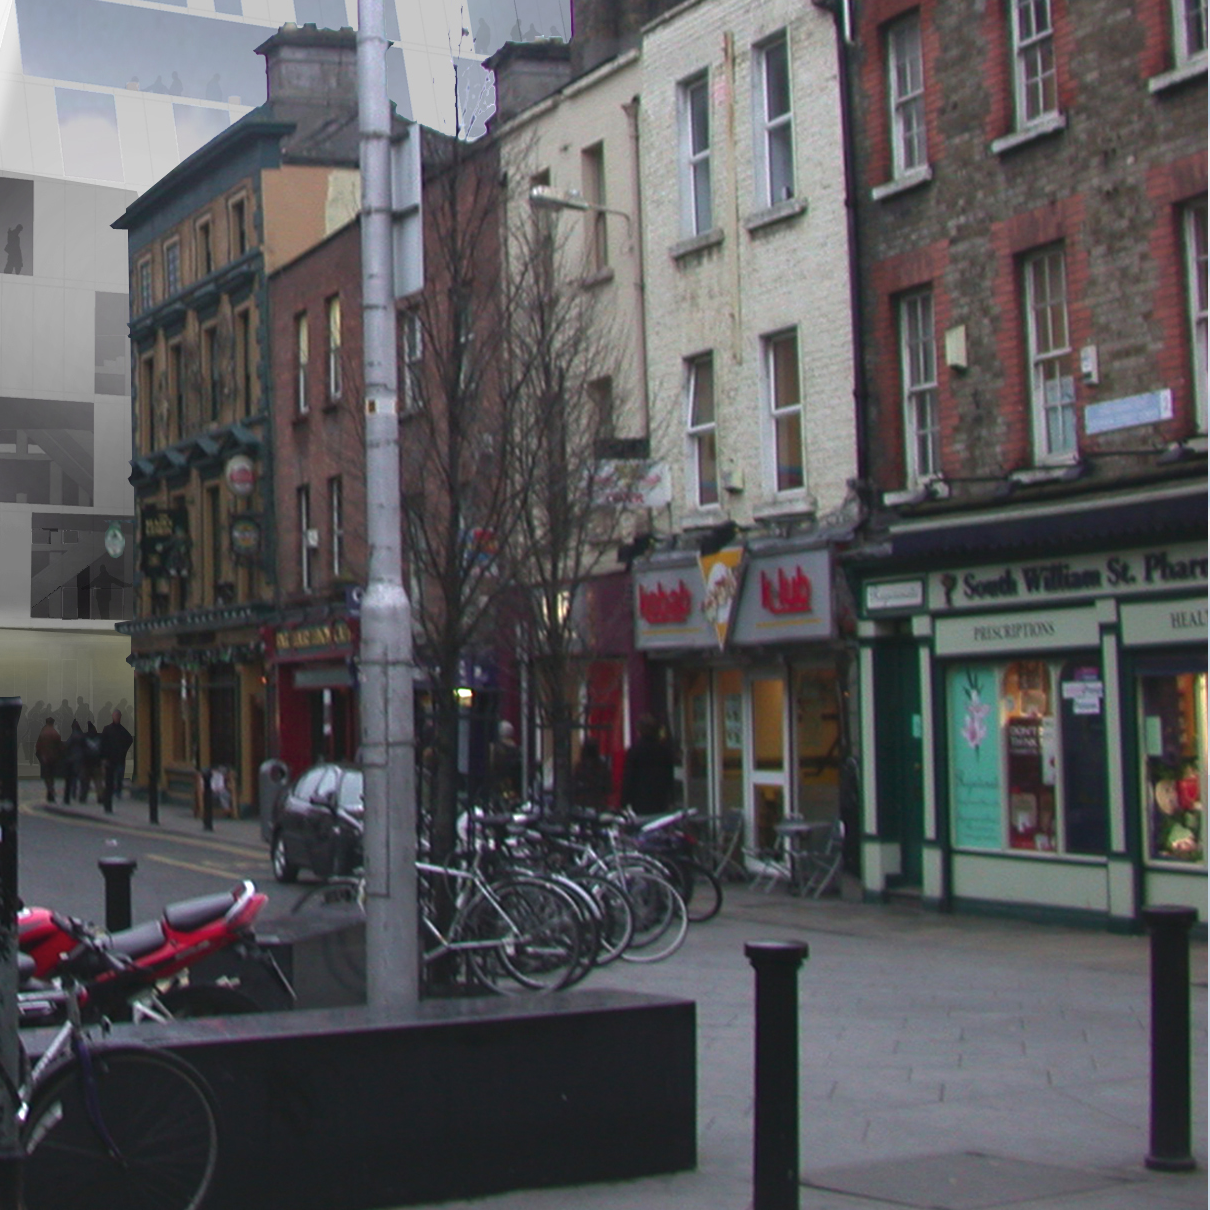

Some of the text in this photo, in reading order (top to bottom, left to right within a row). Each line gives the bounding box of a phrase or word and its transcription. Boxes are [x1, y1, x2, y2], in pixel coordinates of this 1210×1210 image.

[962, 567, 1017, 599] South
[1022, 562, 1101, 593] William
[1106, 556, 1136, 585] St.
[973, 621, 1057, 641] PRESCRIPTIONS
